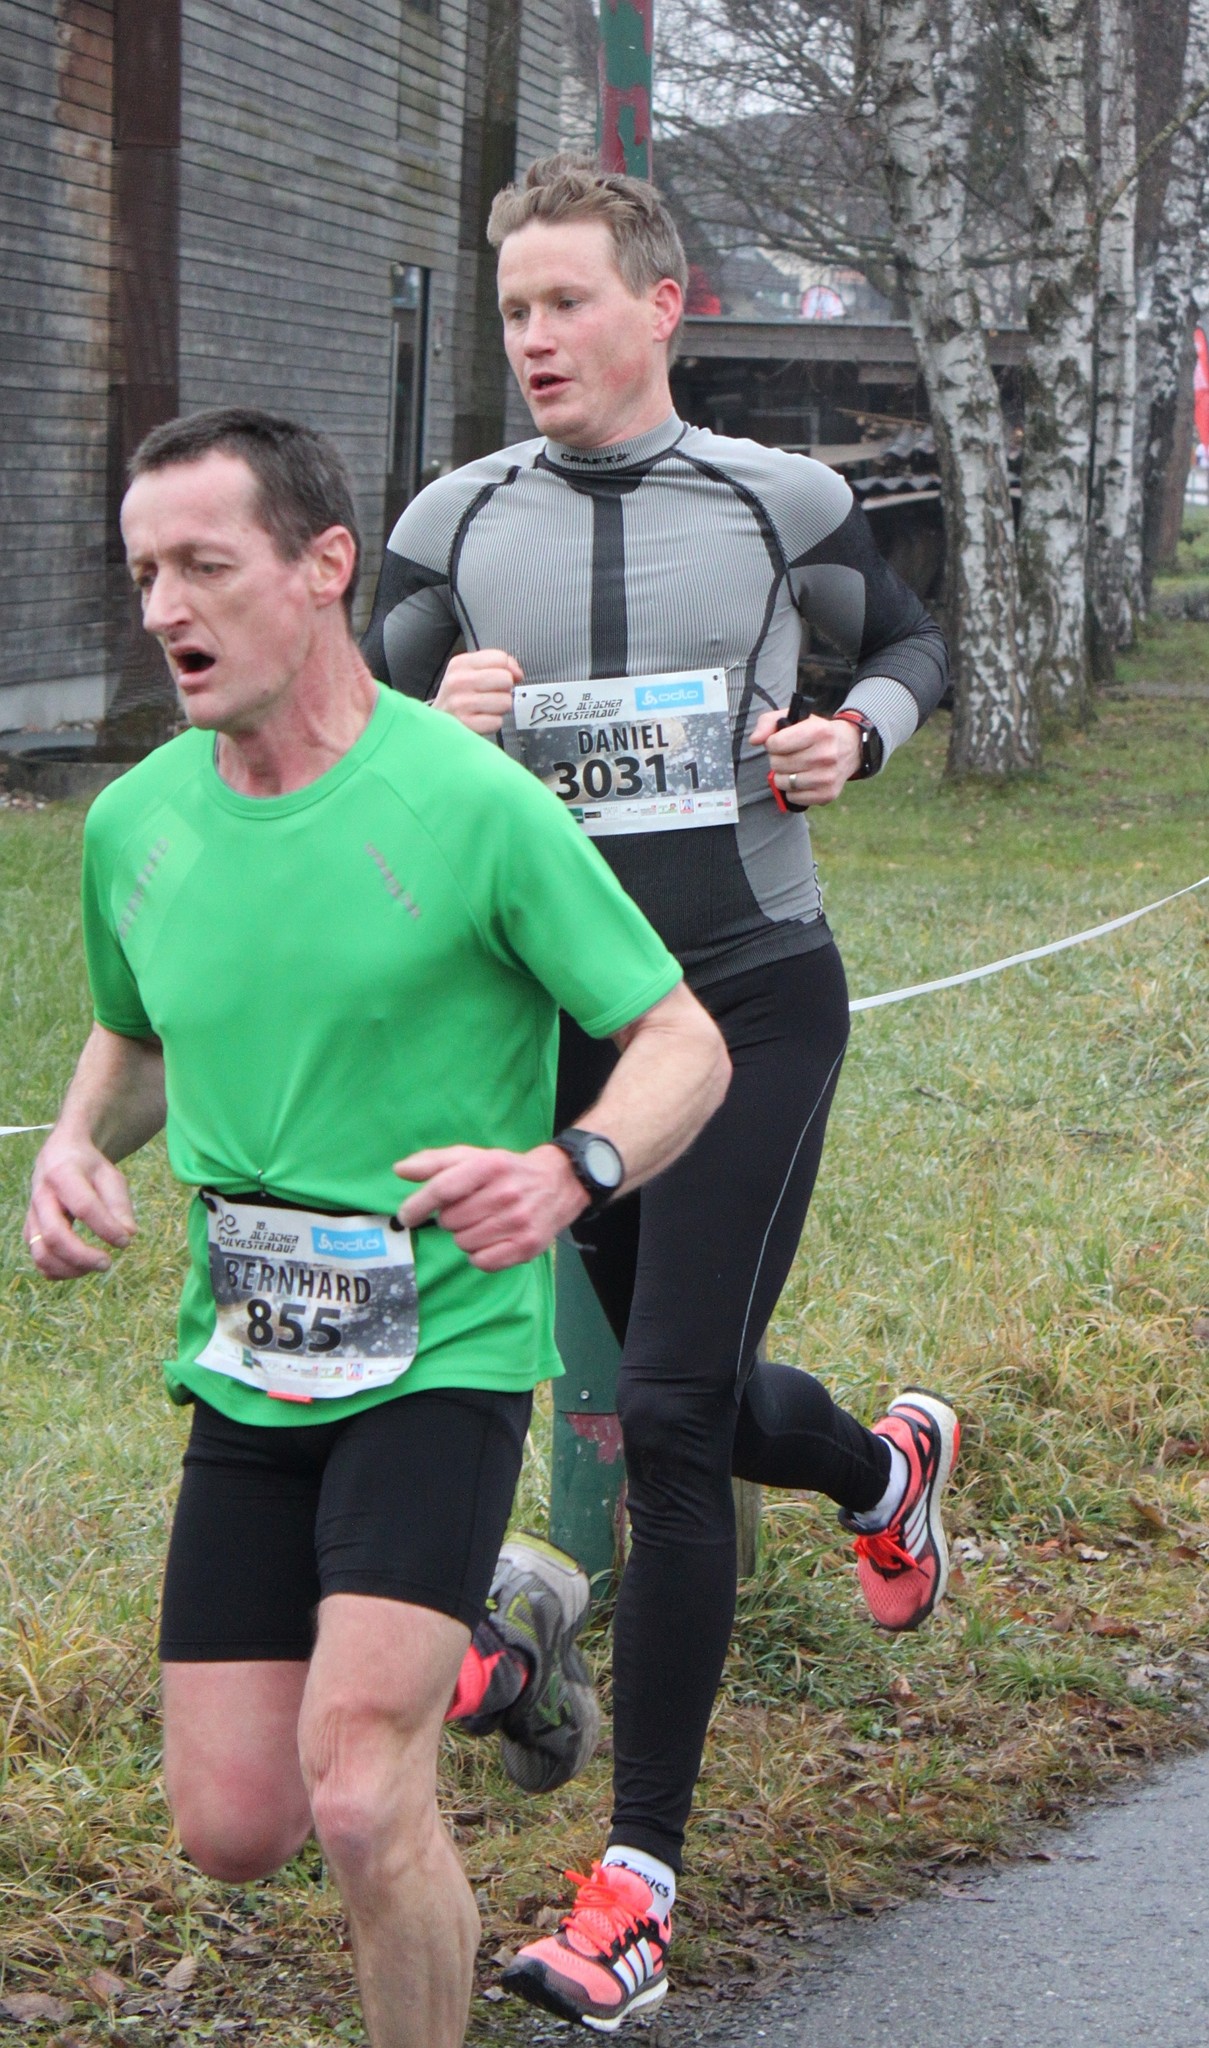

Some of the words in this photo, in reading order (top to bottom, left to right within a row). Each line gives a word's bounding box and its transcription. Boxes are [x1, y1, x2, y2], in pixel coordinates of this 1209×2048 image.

[561, 453, 615, 464] CRAFT
[576, 699, 623, 711] ALTACHER
[547, 708, 620, 722] SILVESTERLAUF
[577, 724, 669, 755] DANIEL
[553, 754, 668, 801] 3031
[684, 762, 700, 790] 1
[218, 1236, 297, 1254] SILVESTERLAUF
[249, 1230, 299, 1245] ALTACHER
[225, 1260, 371, 1304] BERNHARD
[247, 1299, 342, 1353] 855
